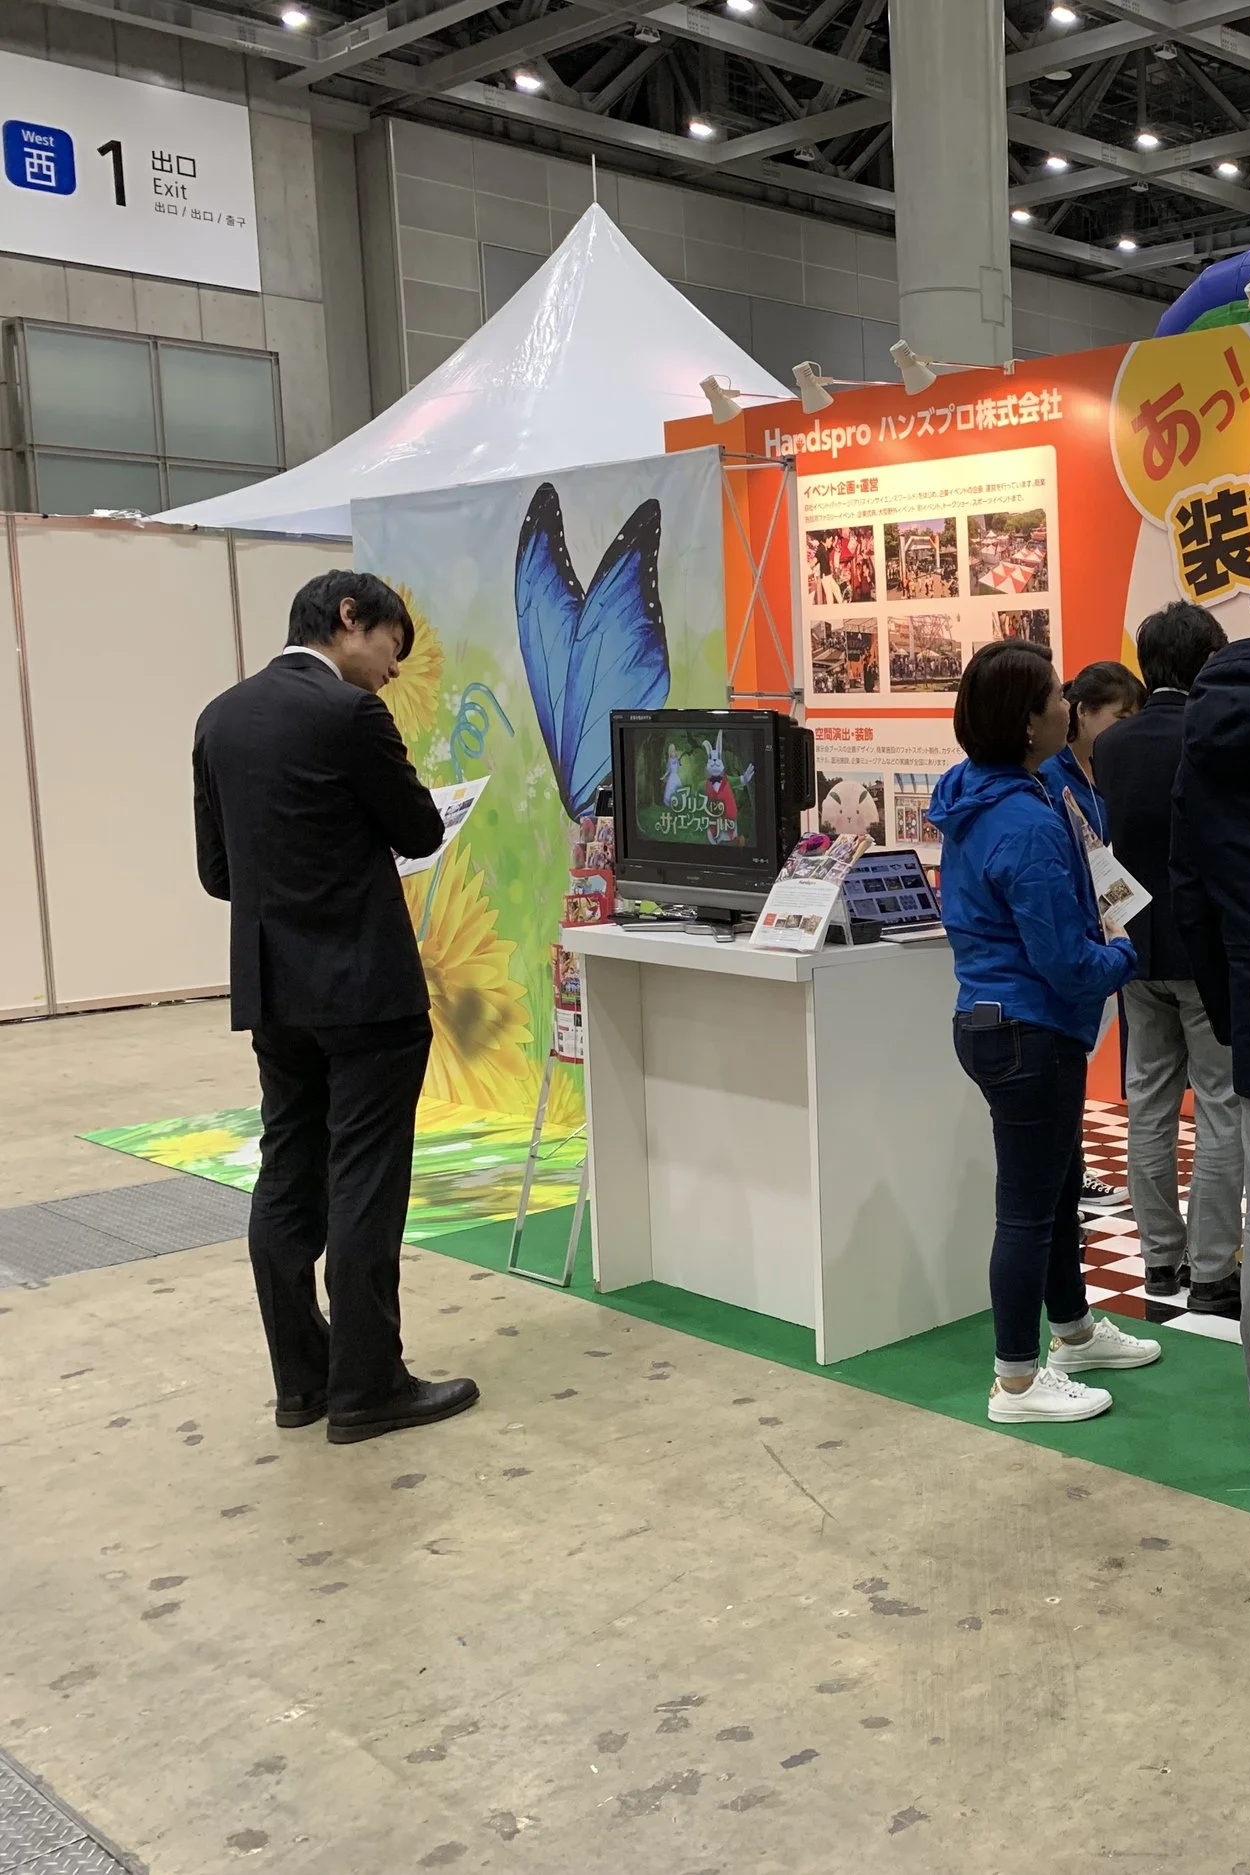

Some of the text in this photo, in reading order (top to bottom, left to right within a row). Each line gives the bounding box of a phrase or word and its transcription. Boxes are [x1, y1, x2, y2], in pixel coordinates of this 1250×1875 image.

[22, 128, 55, 147] West
[24, 147, 56, 187] 西
[97, 140, 126, 207] 1
[152, 151, 196, 178] 出口
[154, 178, 187, 200] Exit
[155, 202, 178, 215] 出口
[191, 209, 213, 222] 出口
[764, 388, 1063, 459] Handspro ハンズプロ株式会社
